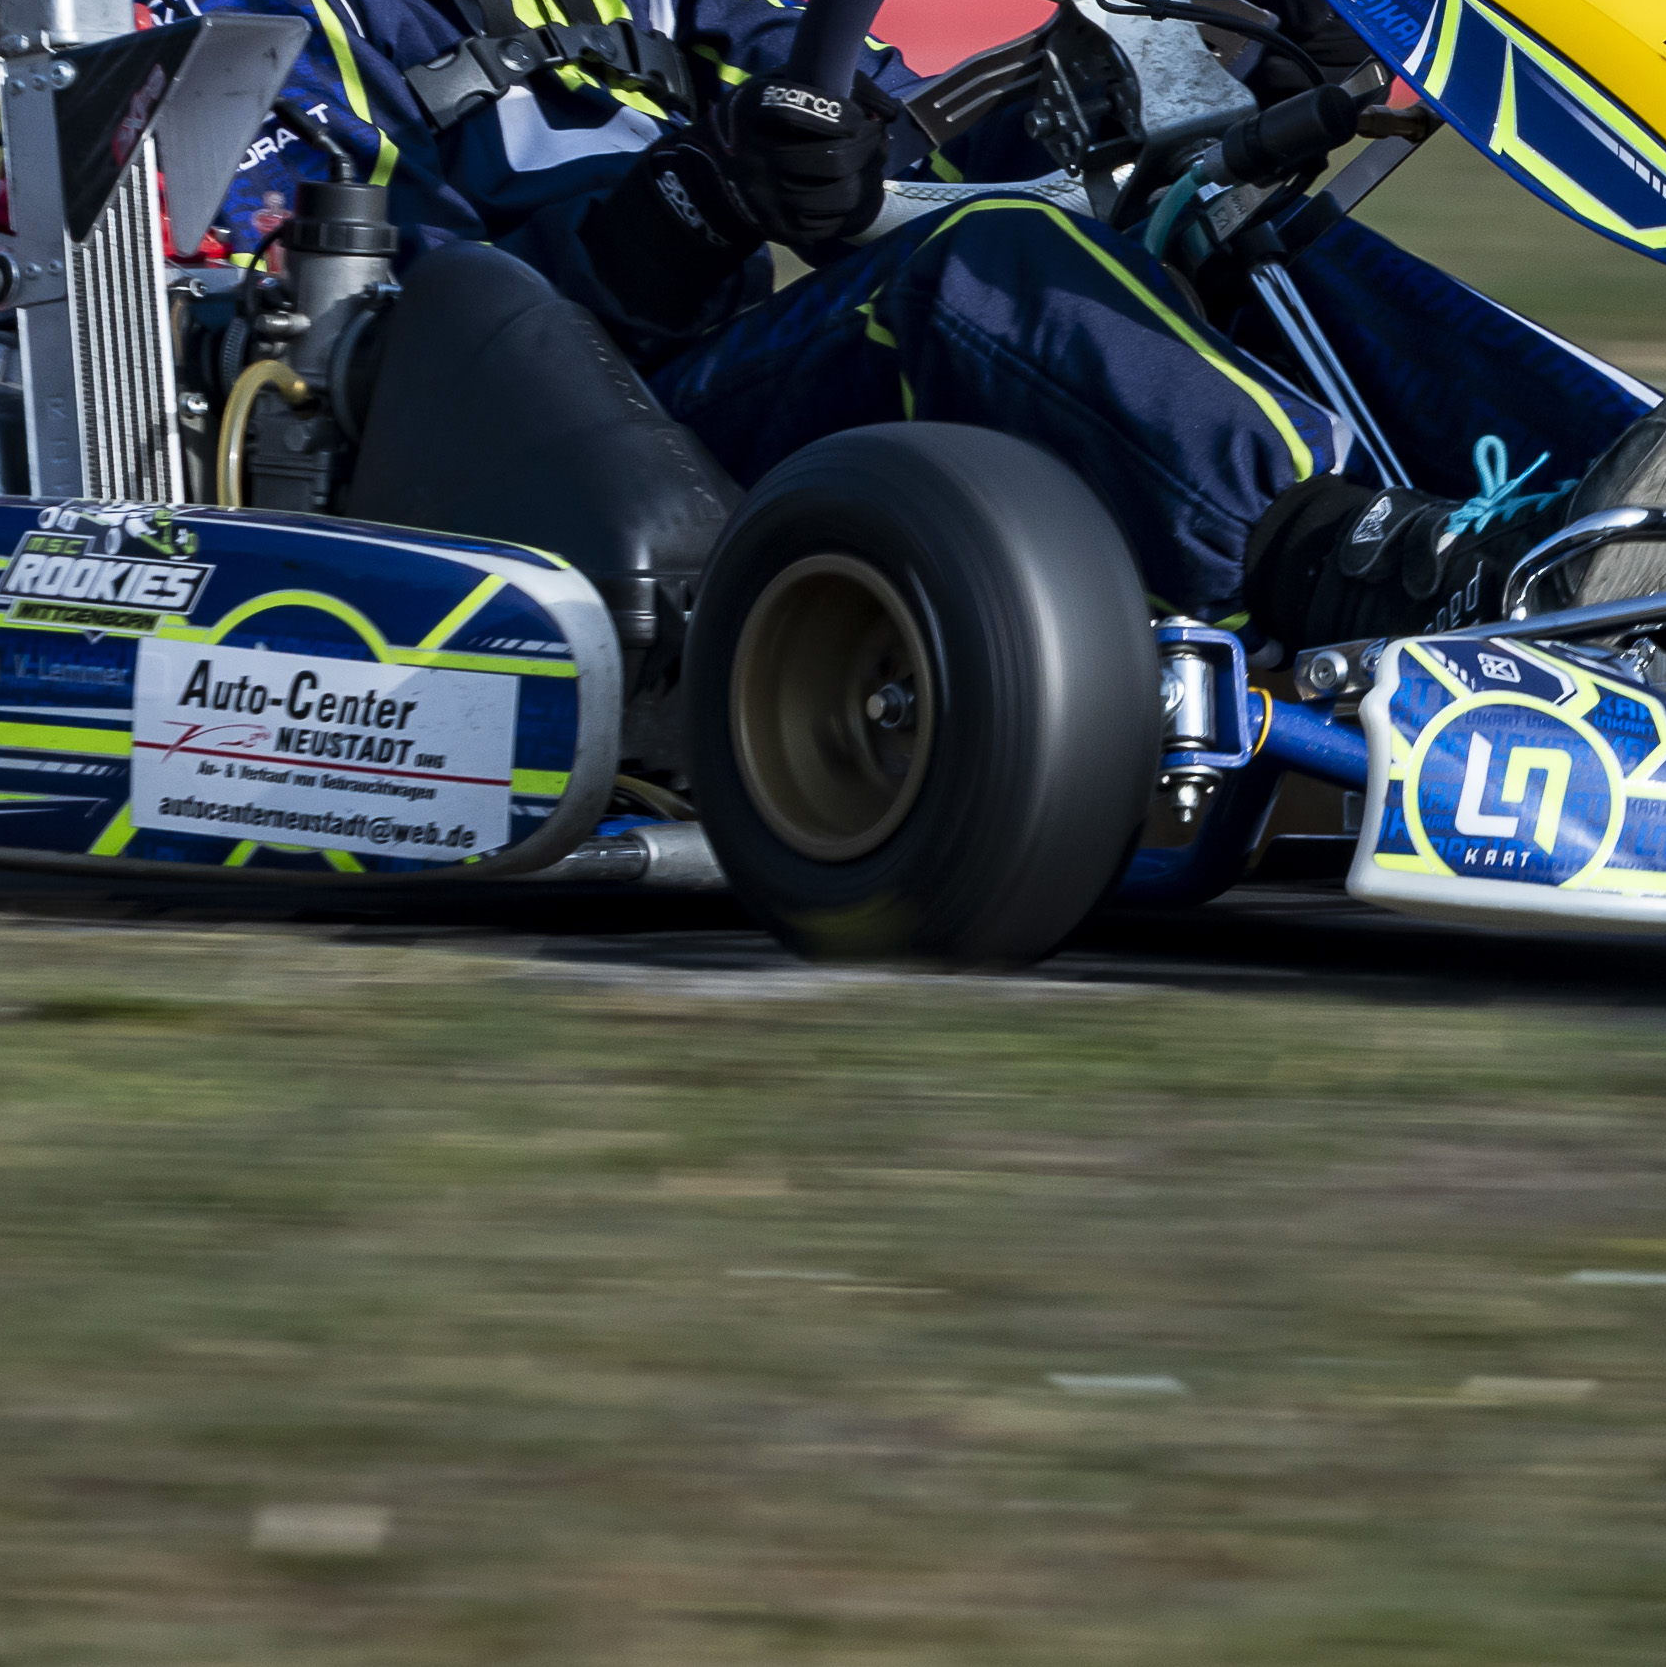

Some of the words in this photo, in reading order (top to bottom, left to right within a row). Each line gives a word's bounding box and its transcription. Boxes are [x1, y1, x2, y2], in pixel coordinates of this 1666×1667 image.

[4, 554, 202, 607] ROOKIES
[178, 659, 419, 731] Auto-Center
[273, 726, 416, 767] NEUSTADT
[158, 794, 478, 850] autocenterneustadt@web.de
[1464, 846, 1531, 868] KART
